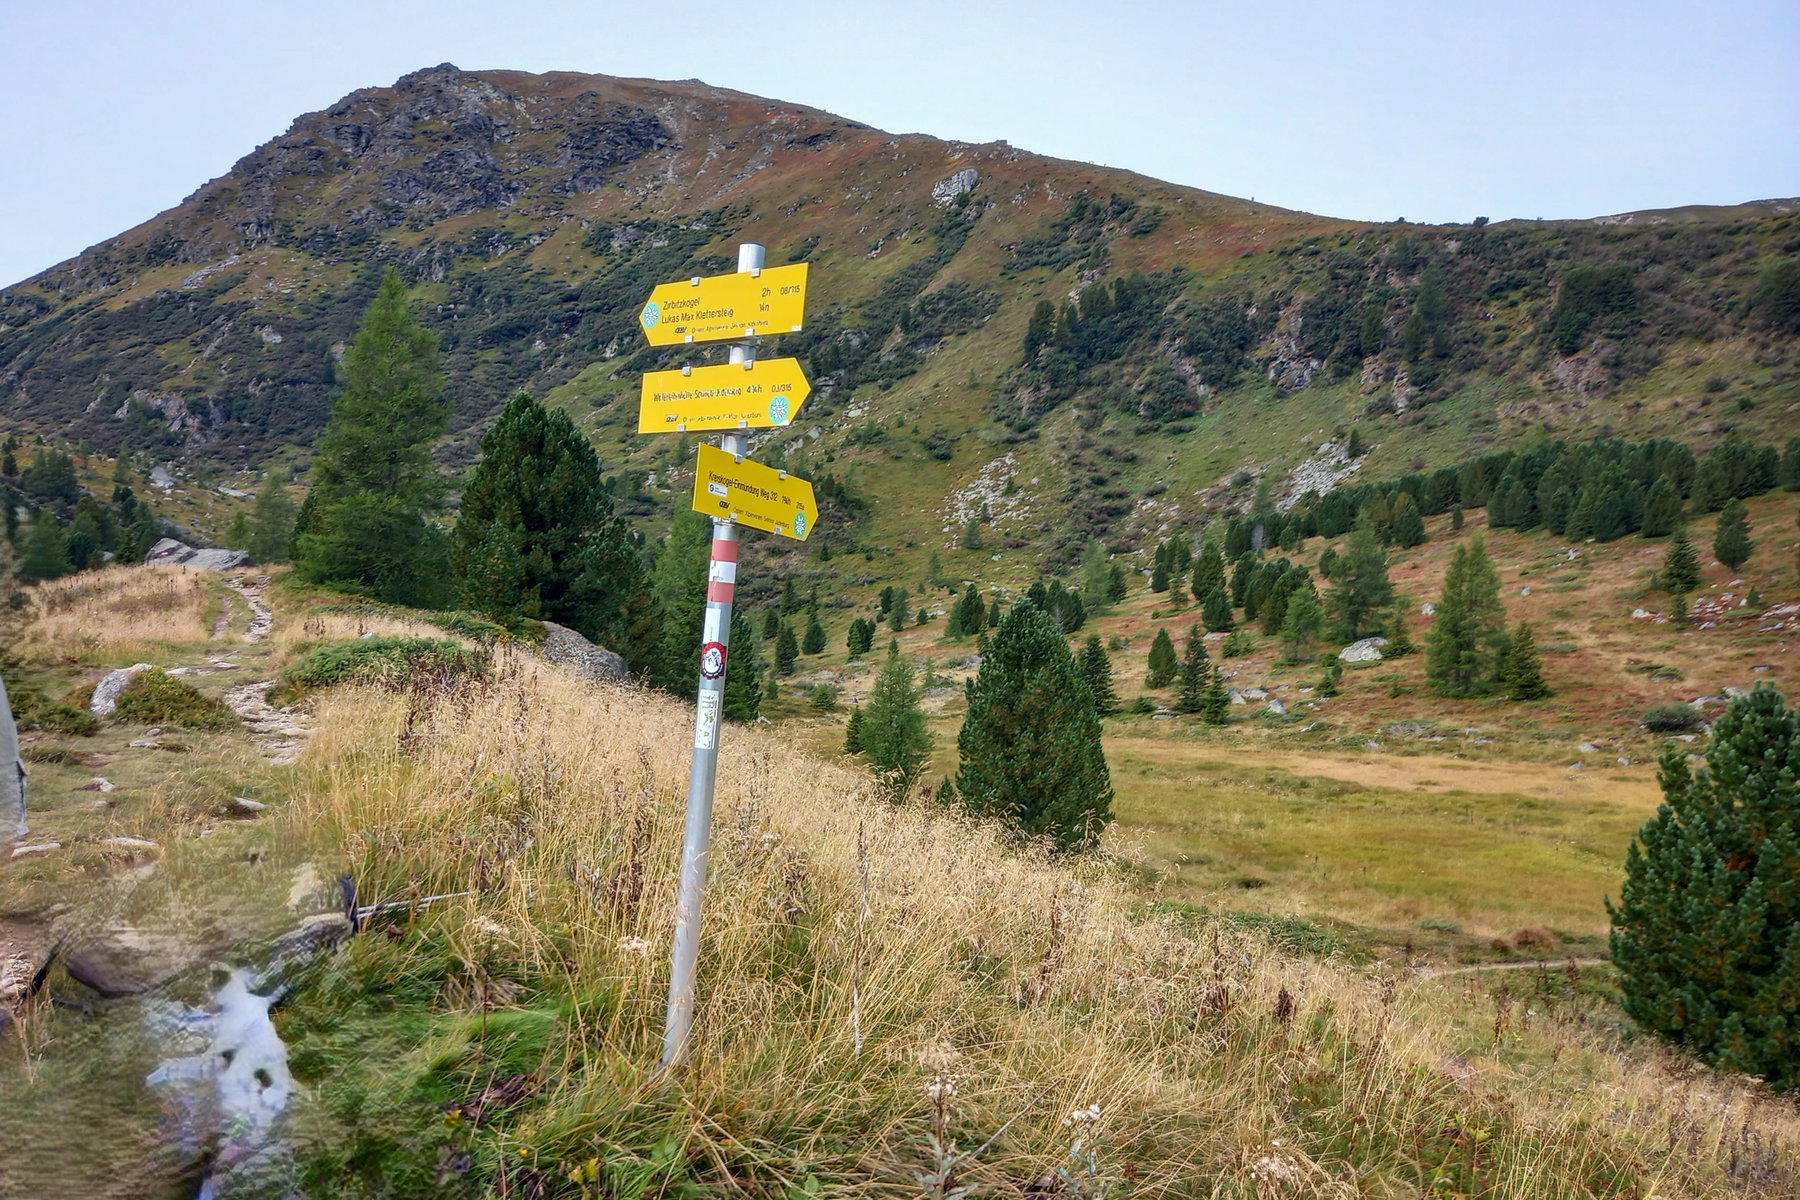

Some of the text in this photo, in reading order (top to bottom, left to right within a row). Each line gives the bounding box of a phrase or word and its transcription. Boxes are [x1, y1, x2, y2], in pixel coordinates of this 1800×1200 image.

[663, 297, 700, 310] Zirbitzkogel
[661, 308, 734, 324] Lukas Max Klettersteig
